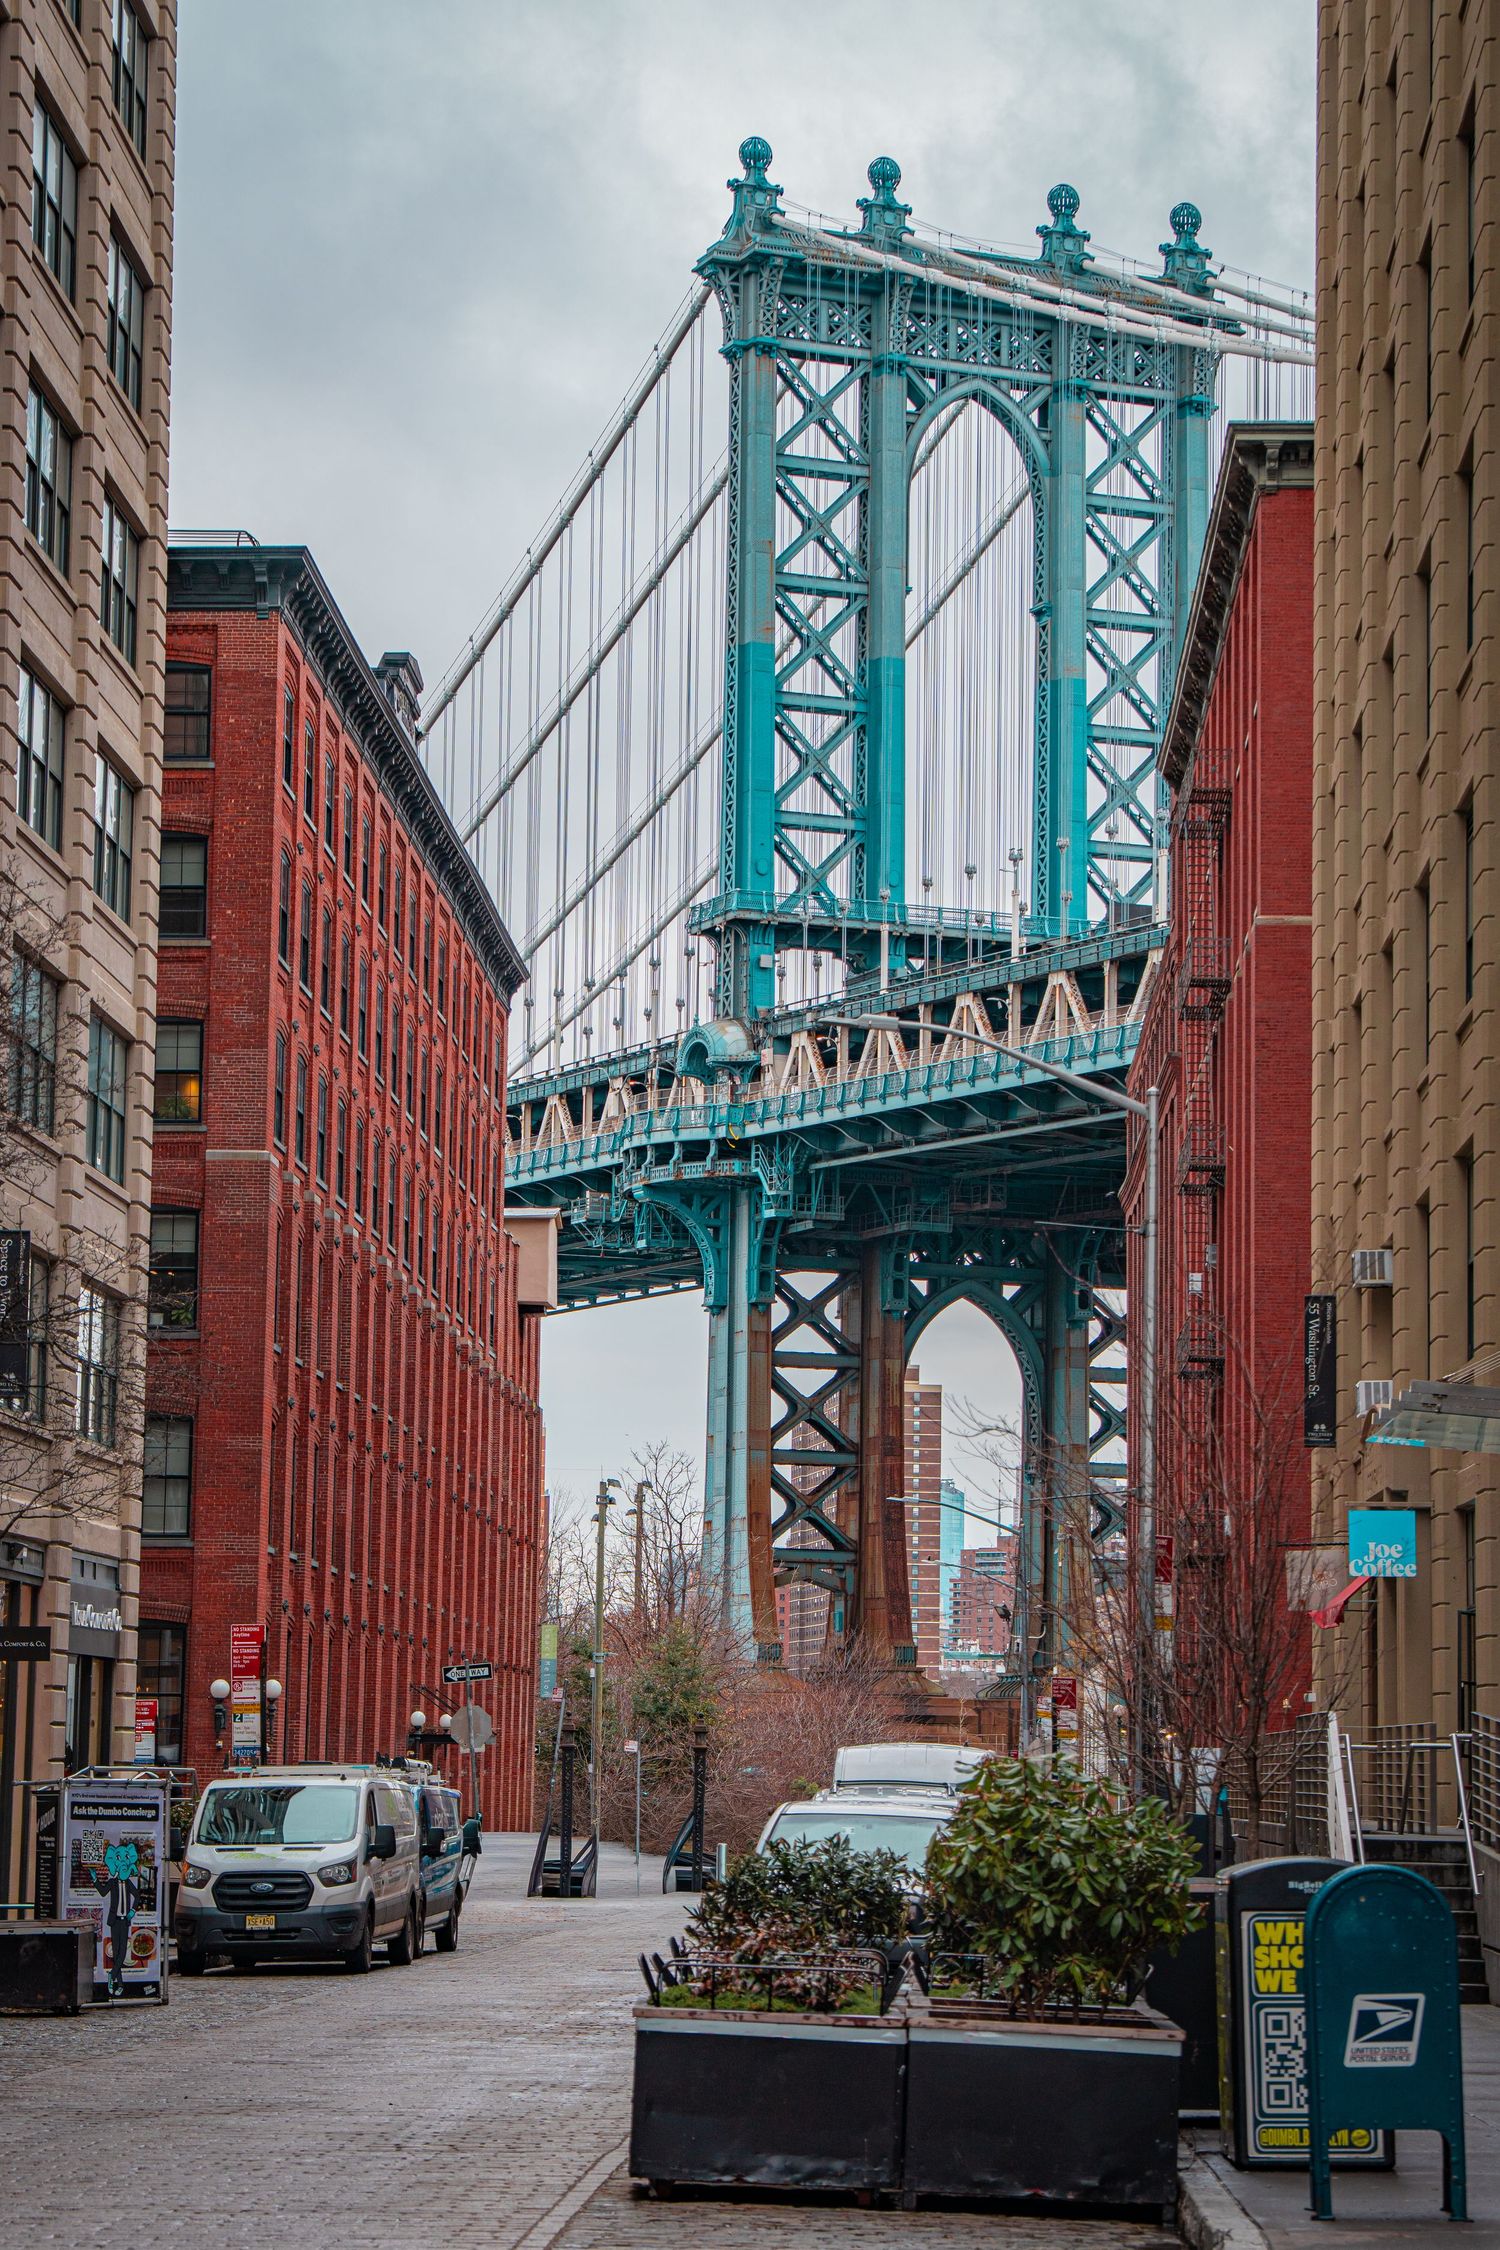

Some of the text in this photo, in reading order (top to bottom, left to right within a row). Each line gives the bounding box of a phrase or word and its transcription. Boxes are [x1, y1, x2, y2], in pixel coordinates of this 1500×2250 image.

[1306, 1303, 1320, 1398] 55 Washington St.
[1364, 1542, 1402, 1562] Joe
[1348, 1558, 1417, 1577] Coffee
[73, 1806, 156, 1818] Ask the Dumbo Concierge
[1255, 1970, 1296, 1992] WE
